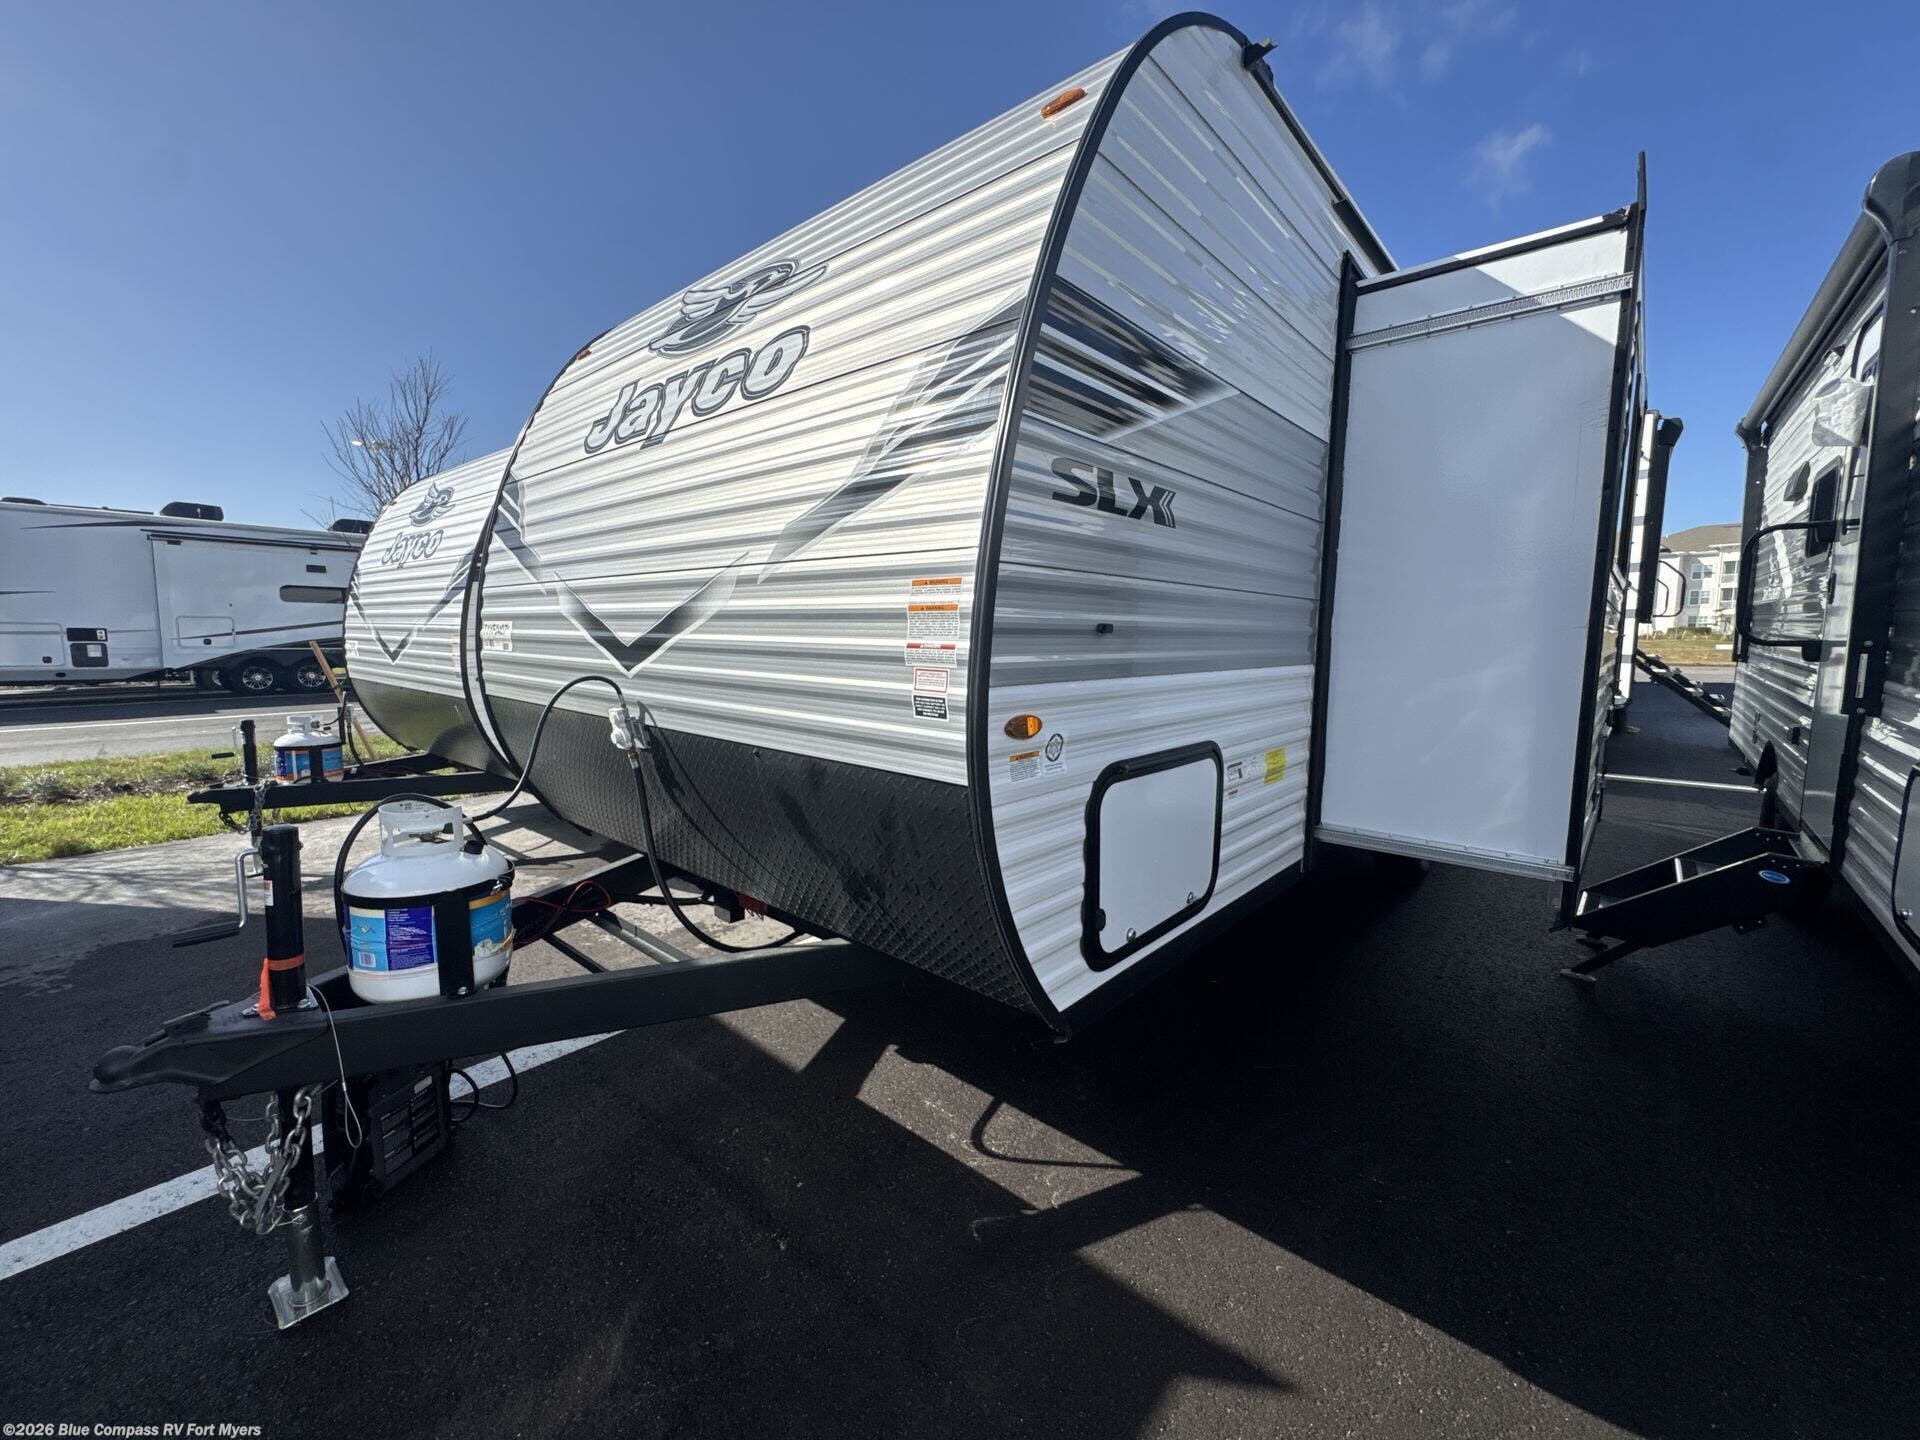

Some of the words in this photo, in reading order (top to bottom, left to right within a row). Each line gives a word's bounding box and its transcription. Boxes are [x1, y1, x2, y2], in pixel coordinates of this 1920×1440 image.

[584, 324, 810, 455] Jayco
[1051, 457, 1176, 529] SLX
[382, 529, 444, 568] Jayco
